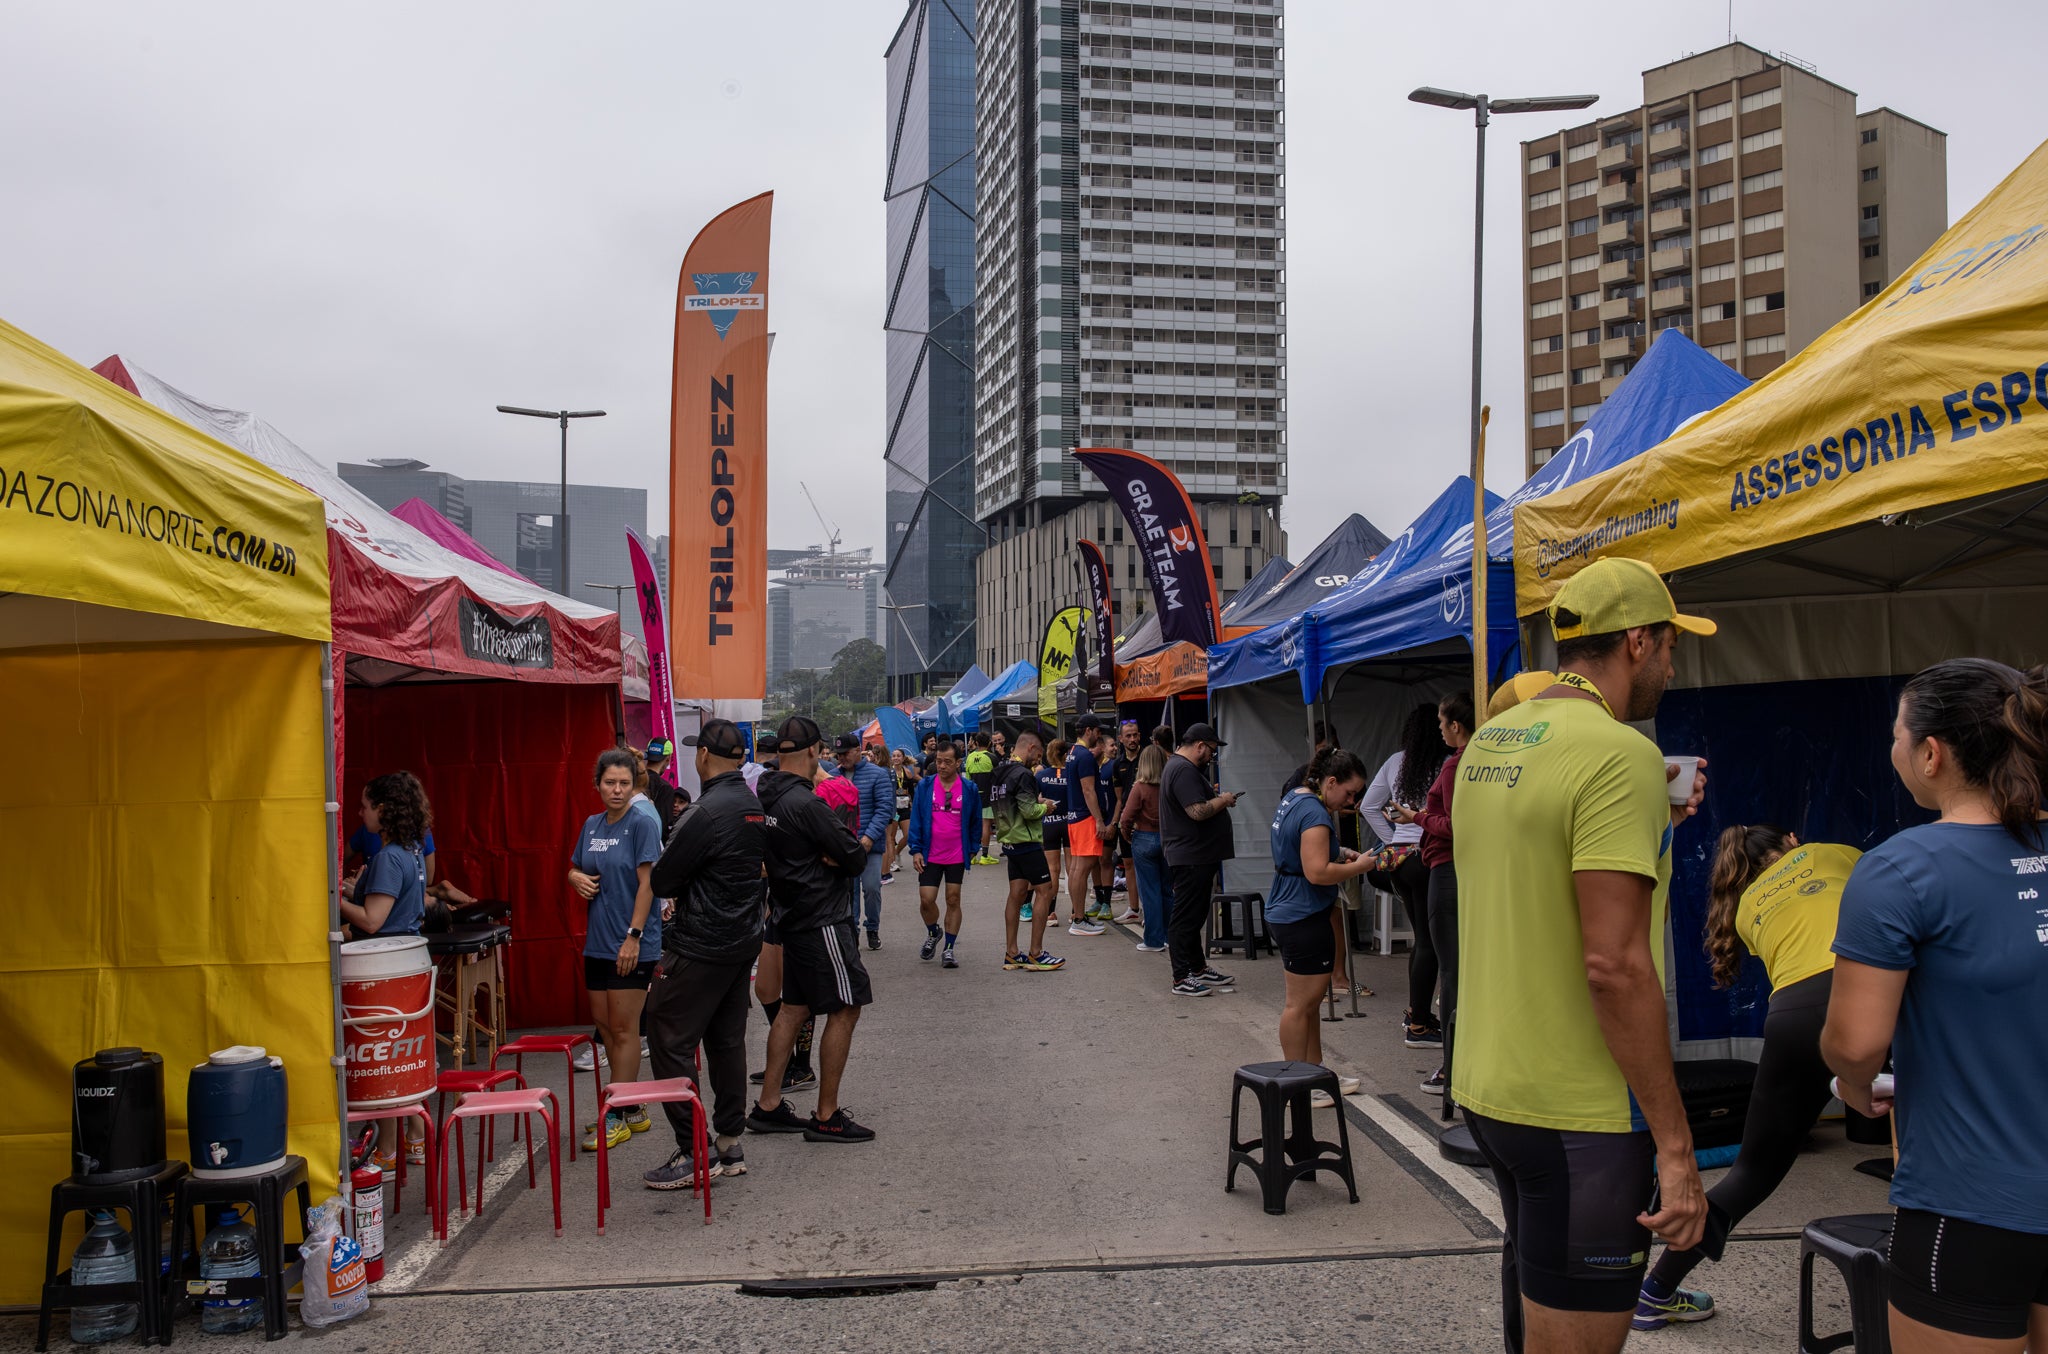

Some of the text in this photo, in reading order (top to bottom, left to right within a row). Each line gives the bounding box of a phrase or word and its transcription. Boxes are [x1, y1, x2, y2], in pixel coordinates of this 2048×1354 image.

[689, 297, 759, 307] TRILOPEZ
[1731, 405, 1936, 512] ASSESSORIA
[709, 375, 734, 645] TRILOPEZ
[1128, 479, 1184, 611] GRAE TEAM
[1091, 564, 1103, 610] GRAE
[1314, 573, 1350, 588] GR
[1560, 673, 1588, 688] 14K
[1462, 761, 1523, 789] running
[2018, 888, 2039, 900] rvb
[344, 1035, 426, 1063] ACEFIT
[346, 1059, 427, 1079] w.pacefit.com.br
